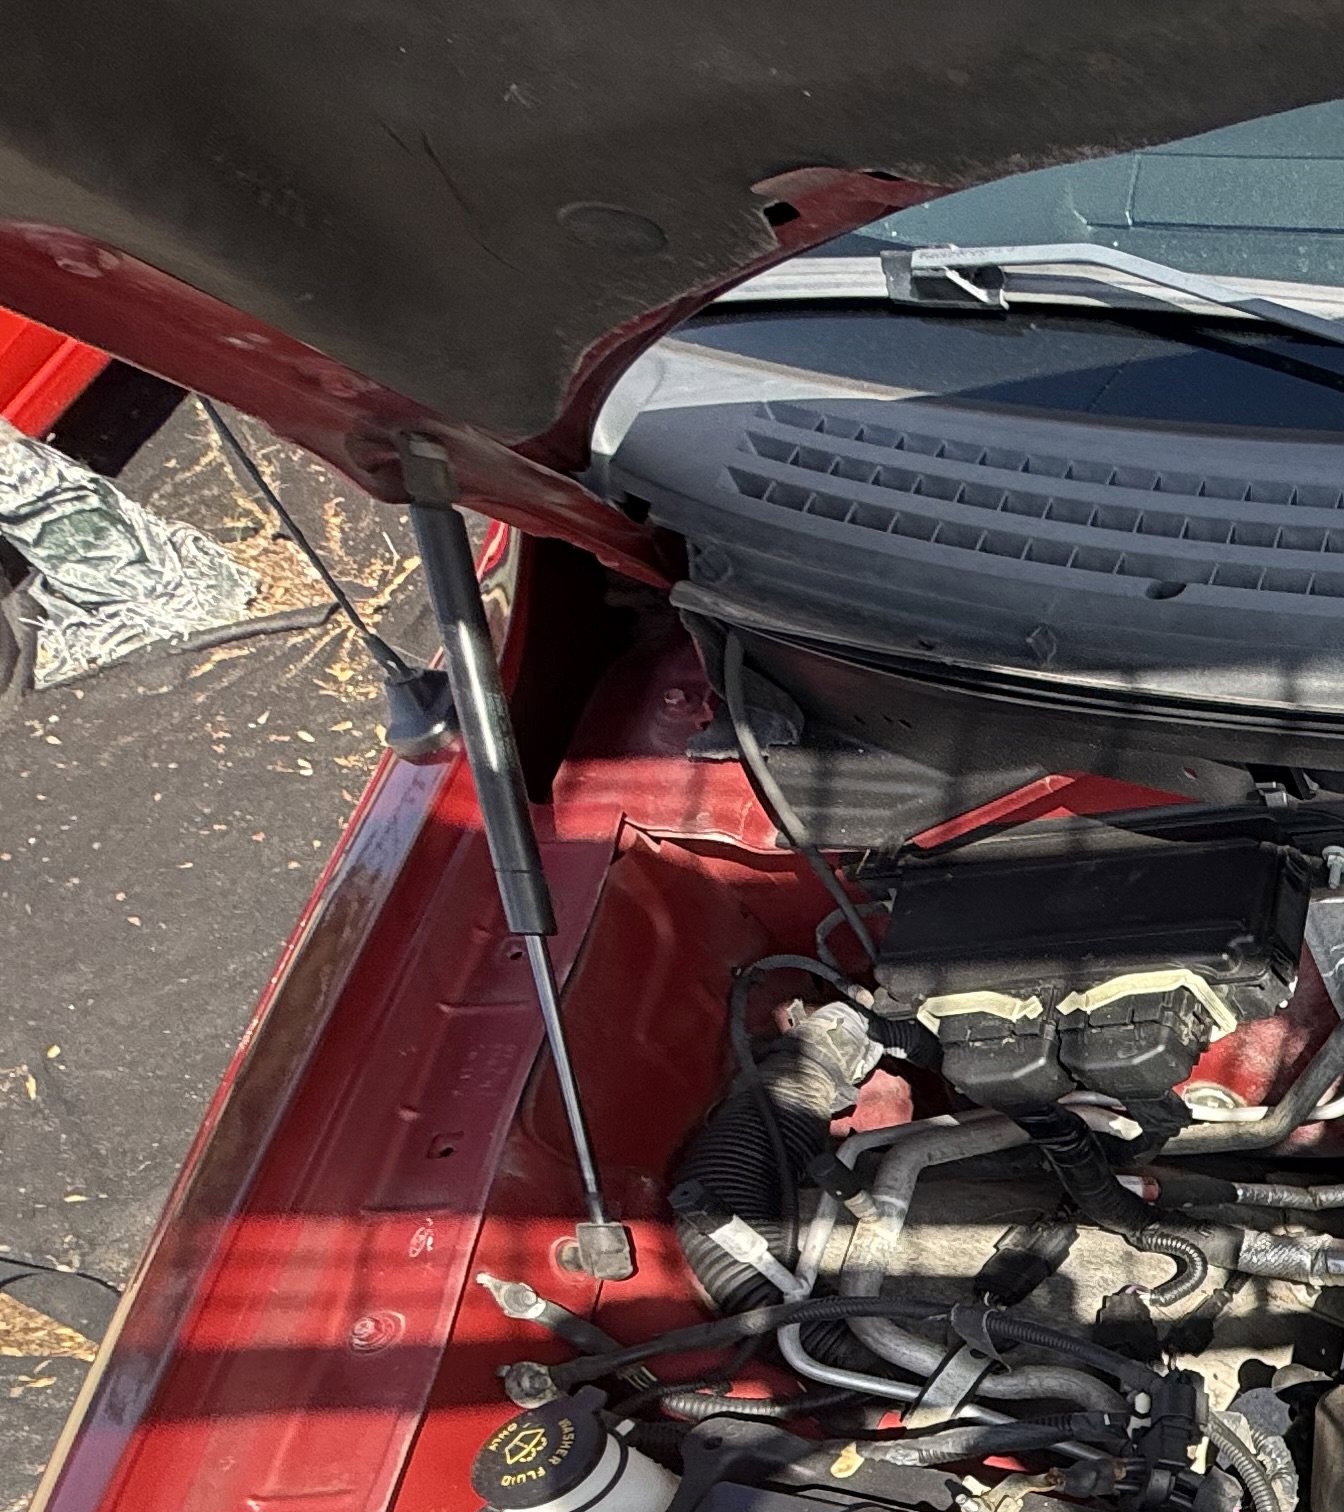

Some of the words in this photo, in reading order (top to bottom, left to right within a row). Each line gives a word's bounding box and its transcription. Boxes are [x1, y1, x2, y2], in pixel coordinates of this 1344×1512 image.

[488, 1422, 518, 1452] ONLY
[548, 1418, 575, 1465] WASHER
[501, 1466, 546, 1487] FLUID
